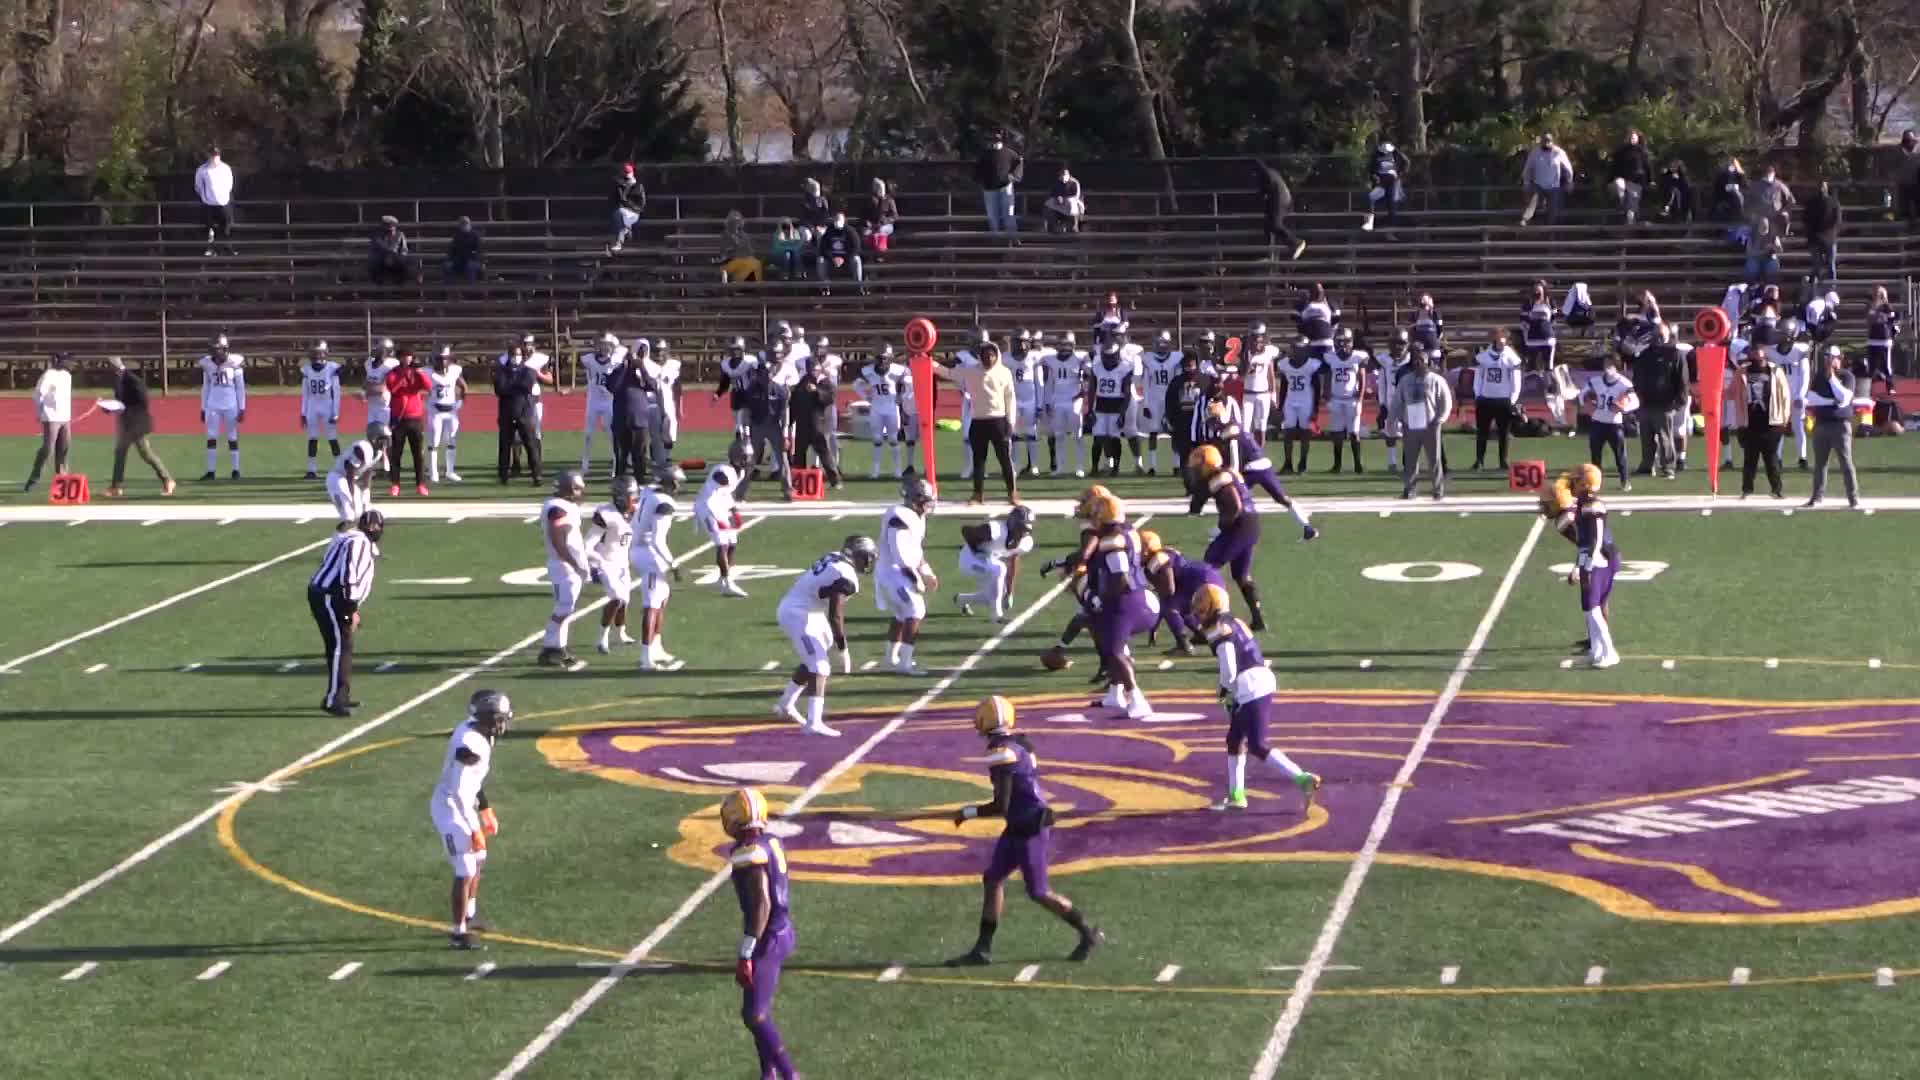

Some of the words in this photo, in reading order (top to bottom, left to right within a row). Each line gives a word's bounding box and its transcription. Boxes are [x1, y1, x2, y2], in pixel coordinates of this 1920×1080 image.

[1224, 337, 1241, 364] 2
[1100, 378, 1116, 393] 29
[1290, 376, 1304, 391] 35
[1513, 465, 1542, 488] 50
[54, 480, 81, 501] 30
[1504, 805, 1759, 844] THE
